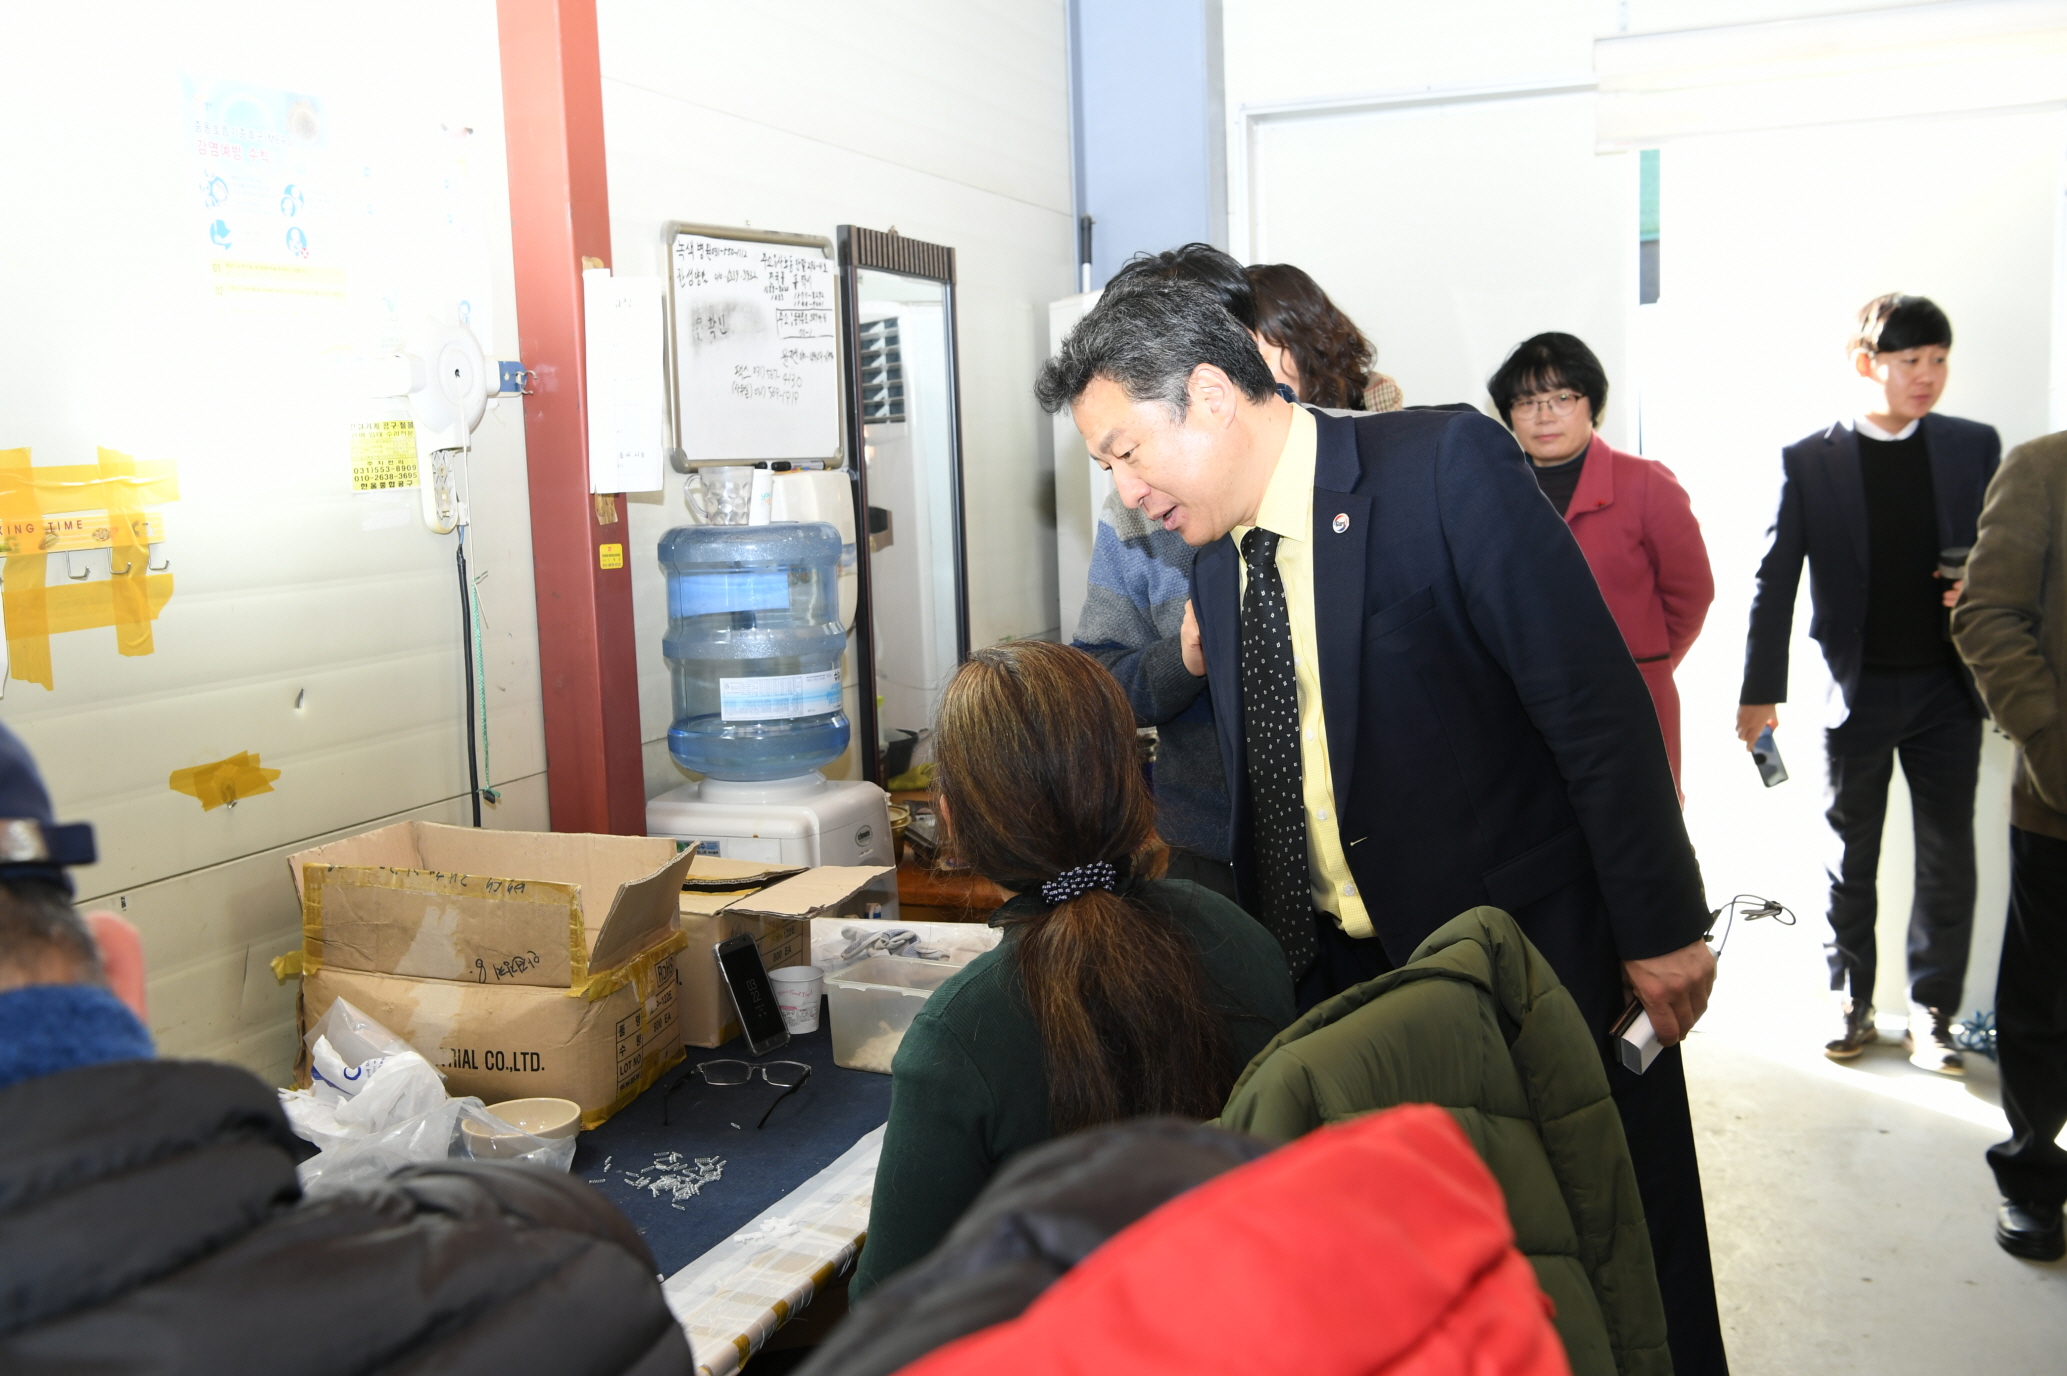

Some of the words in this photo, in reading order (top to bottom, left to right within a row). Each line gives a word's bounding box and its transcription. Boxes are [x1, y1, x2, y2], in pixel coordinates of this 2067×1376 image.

[196, 139, 242, 161] 감염예방
[248, 147, 270, 163] 수칙
[676, 240, 694, 261] 녹색
[354, 472, 418, 482] 010-2638-3695
[47, 519, 83, 533] TIME
[664, 1011, 671, 1024] EA
[619, 1044, 626, 1057] 수
[485, 1050, 545, 1073] CO.,LTD.
[619, 1059, 631, 1076] LOT
[633, 1053, 642, 1066] NO
